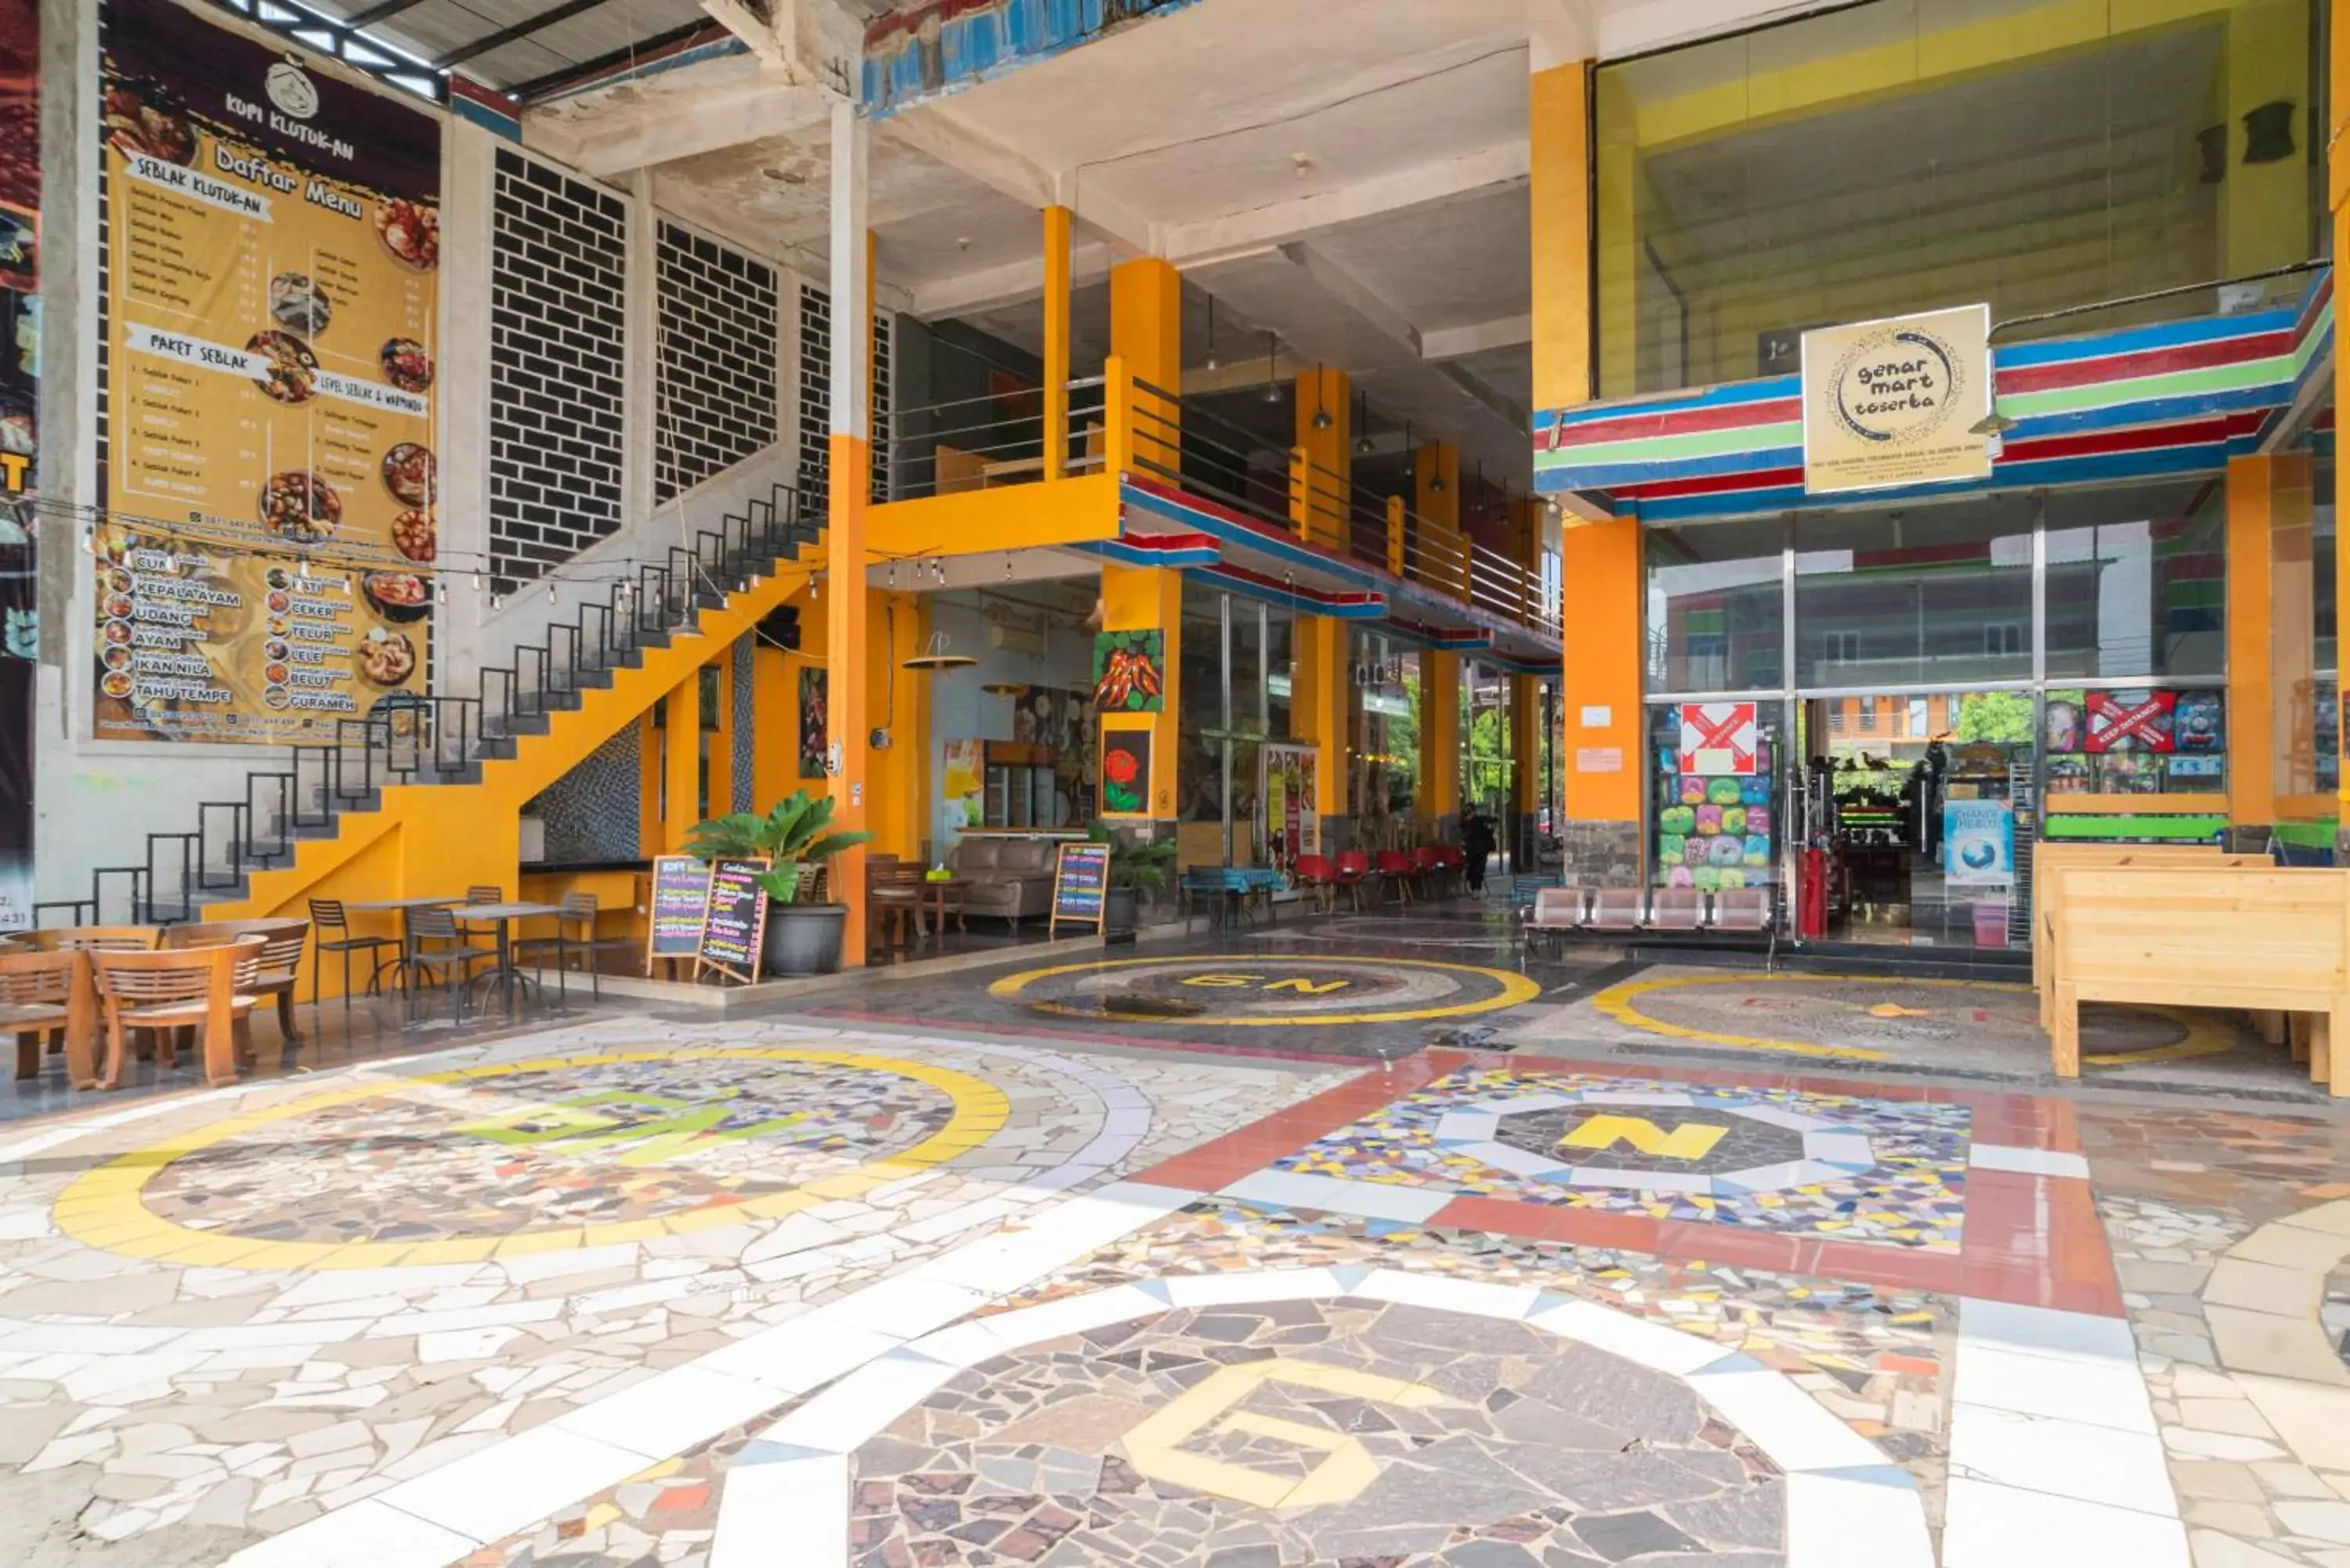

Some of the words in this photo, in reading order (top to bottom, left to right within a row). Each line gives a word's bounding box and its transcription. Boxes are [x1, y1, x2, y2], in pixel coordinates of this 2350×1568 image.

[270, 110, 353, 161] KLUTUK-AN
[138, 158, 187, 186] SEBLAK
[193, 178, 261, 213] KLUTUK-AN
[215, 144, 298, 194] Daftar
[306, 179, 363, 221] Menu
[150, 334, 193, 356] PAKET
[201, 347, 248, 369] SEBLAK
[1858, 359, 1928, 385] genar
[1871, 373, 1933, 396] mart
[198, 592, 239, 605] AYAM
[136, 634, 179, 647] AYAM
[292, 627, 332, 640] TELUR
[136, 659, 172, 672] IKAN
[177, 664, 211, 674] NILA
[136, 685, 176, 697] TAHU
[178, 688, 230, 701] TEMPE
[2099, 727, 2120, 742] KEEP
